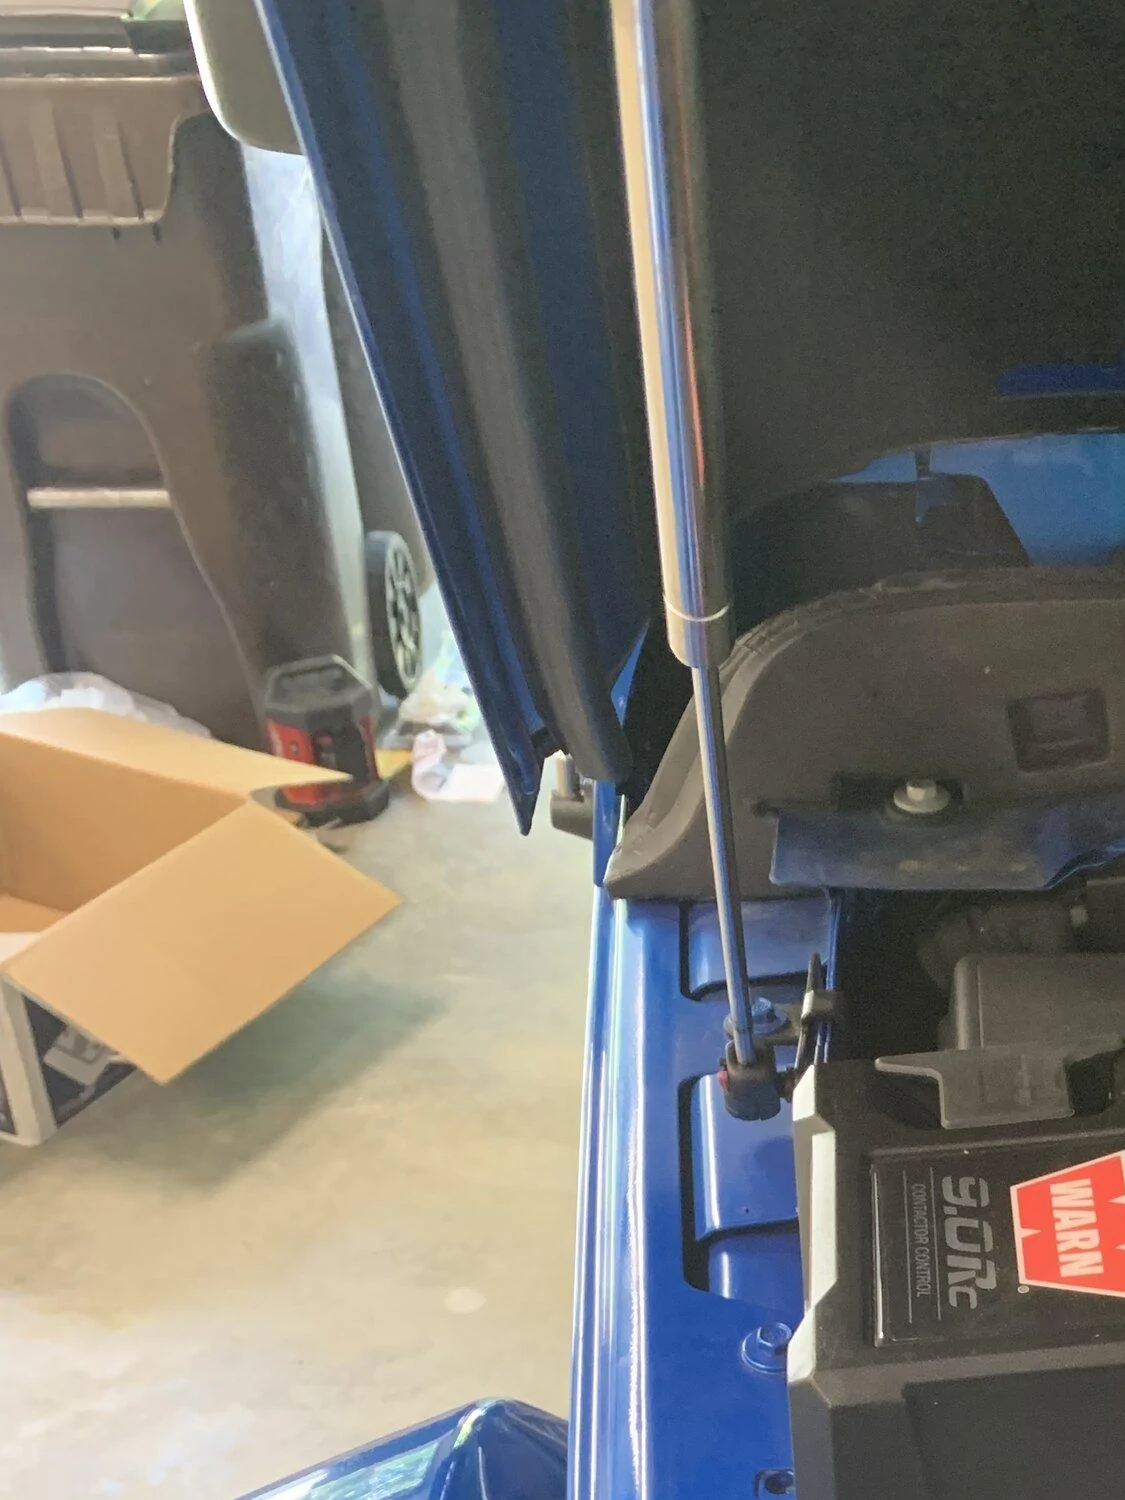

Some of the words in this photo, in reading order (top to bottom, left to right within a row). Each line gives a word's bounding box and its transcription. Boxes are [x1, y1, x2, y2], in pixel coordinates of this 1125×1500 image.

[911, 1183, 930, 1245] CONTACTOR
[1049, 1177, 1105, 1278] WARN
[914, 1246, 932, 1298] CONTROL
